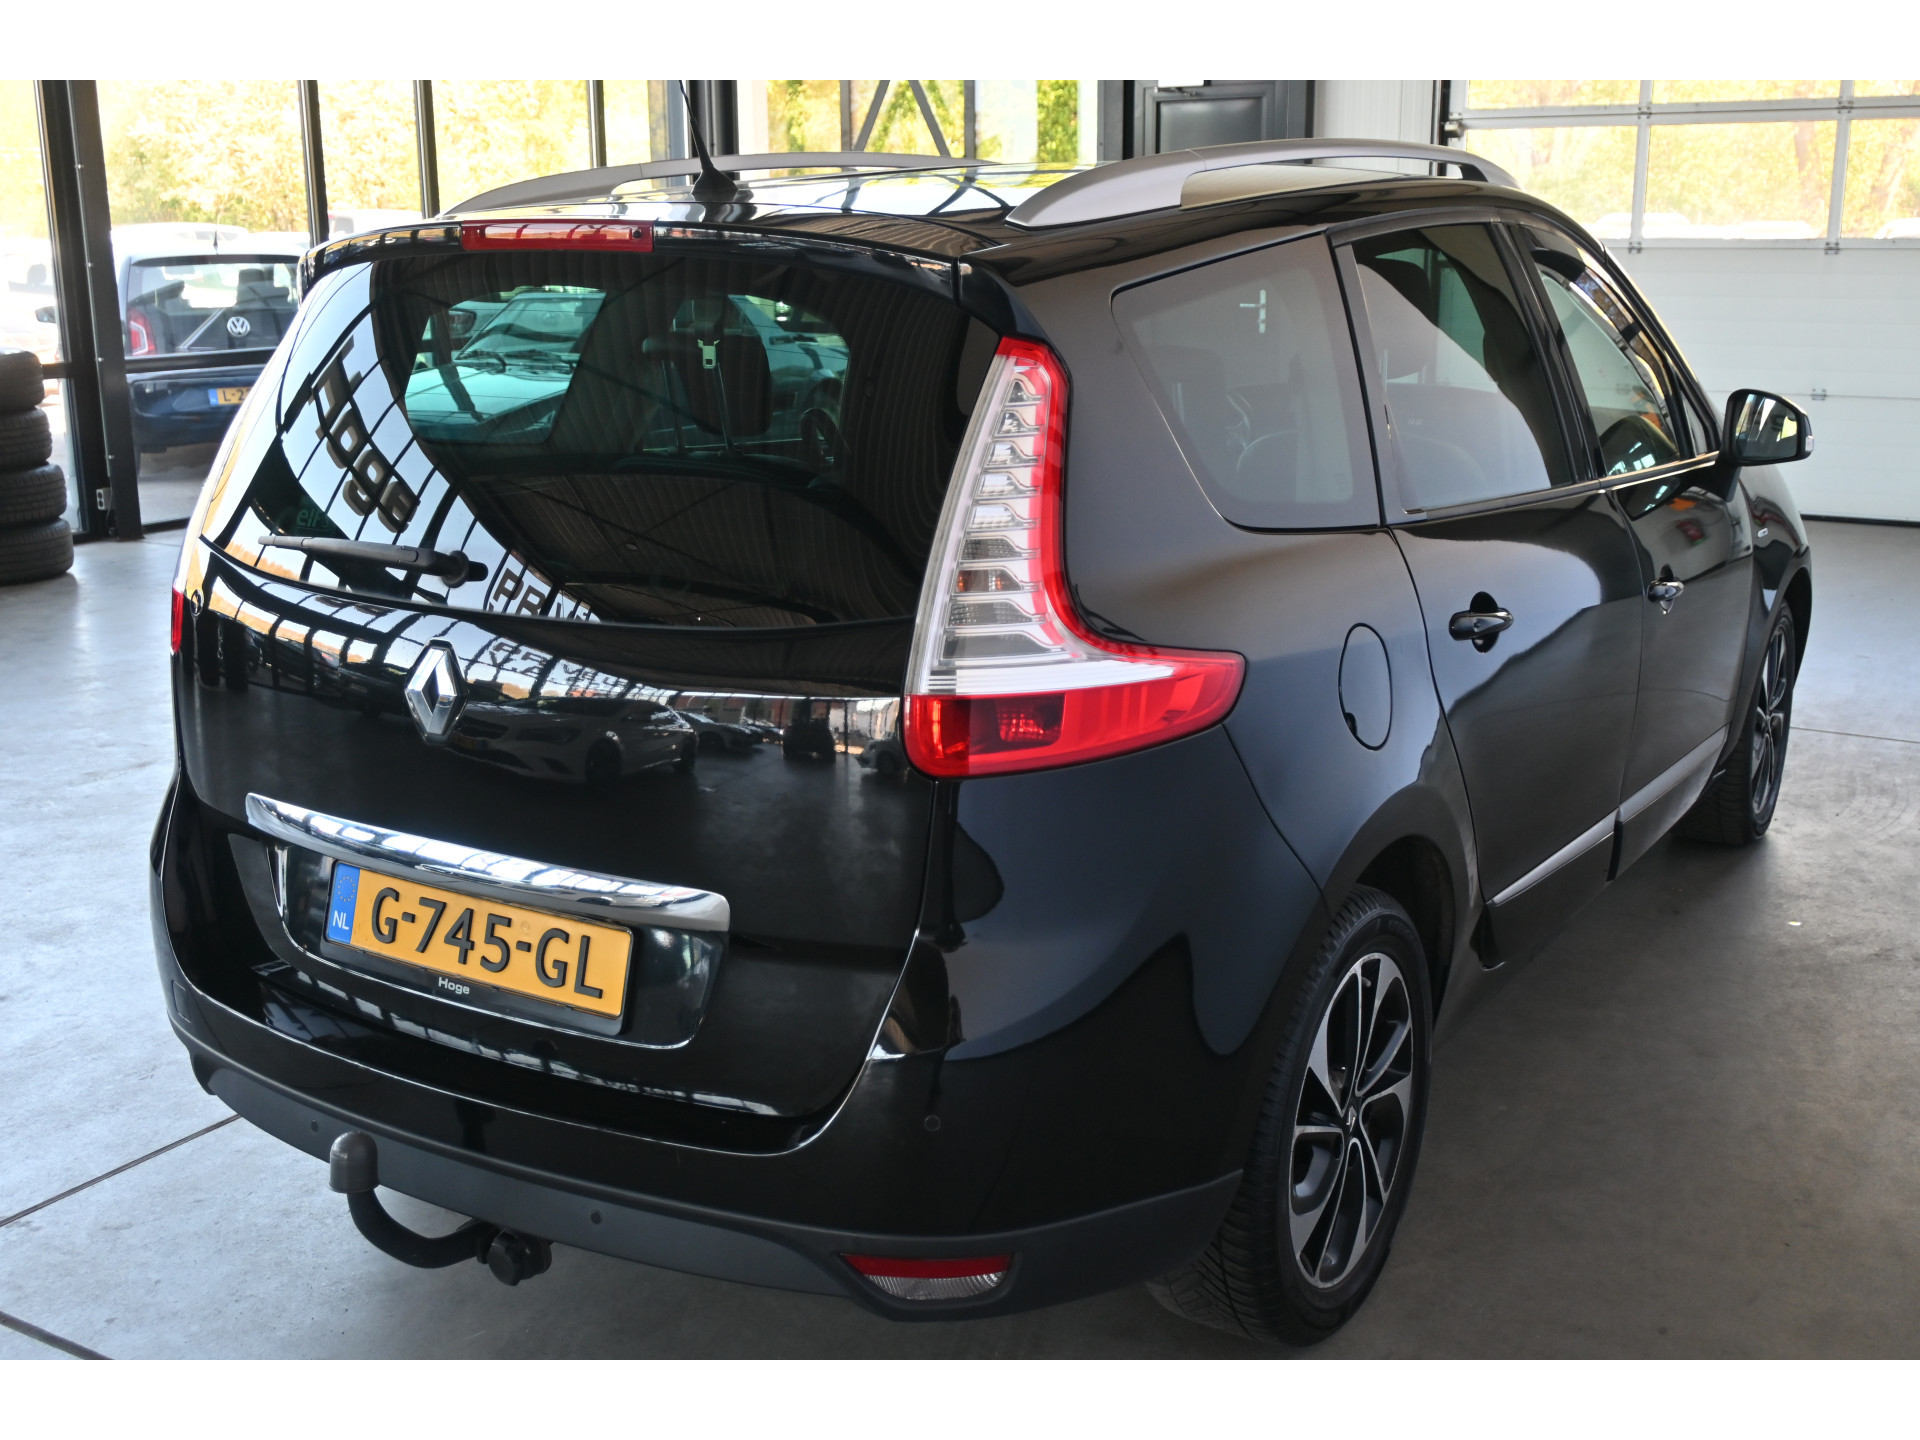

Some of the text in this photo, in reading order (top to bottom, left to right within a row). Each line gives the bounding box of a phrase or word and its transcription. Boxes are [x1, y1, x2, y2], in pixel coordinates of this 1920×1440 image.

[222, 388, 249, 402] L-2
[332, 910, 350, 931] NL
[371, 887, 603, 999] G-745-GL
[438, 976, 470, 995] Hoge
